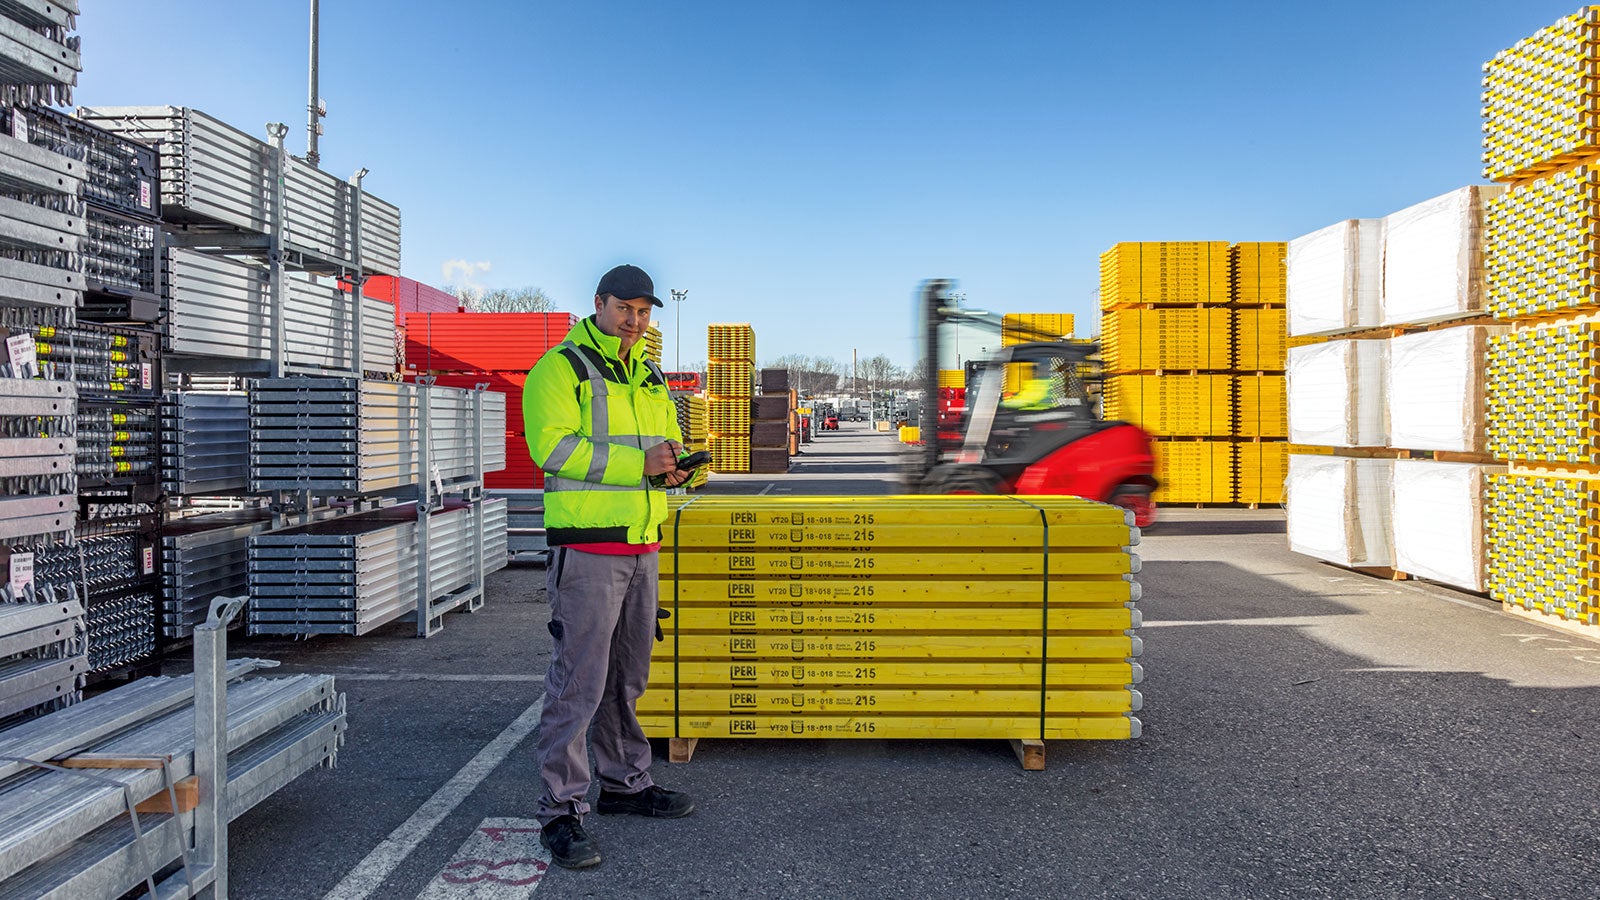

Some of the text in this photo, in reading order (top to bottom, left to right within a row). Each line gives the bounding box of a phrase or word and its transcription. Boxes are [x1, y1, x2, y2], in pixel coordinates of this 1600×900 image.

[735, 512, 757, 523] PERI
[770, 516, 789, 524] VT20
[854, 514, 874, 525] 215
[732, 529, 755, 539] PERI
[854, 530, 875, 541] 215
[732, 556, 755, 567] PERI
[854, 557, 875, 568] 215
[732, 583, 754, 594] PERI
[853, 585, 874, 596] 215
[733, 611, 756, 621] PERI
[854, 613, 875, 623] 215
[733, 638, 756, 649] PERI
[855, 640, 876, 651] 215
[734, 666, 756, 676] PERI
[855, 668, 876, 678] 215
[734, 693, 756, 704] PERI
[855, 695, 876, 705] 215
[733, 720, 756, 731] PERI
[855, 722, 876, 732] 215
